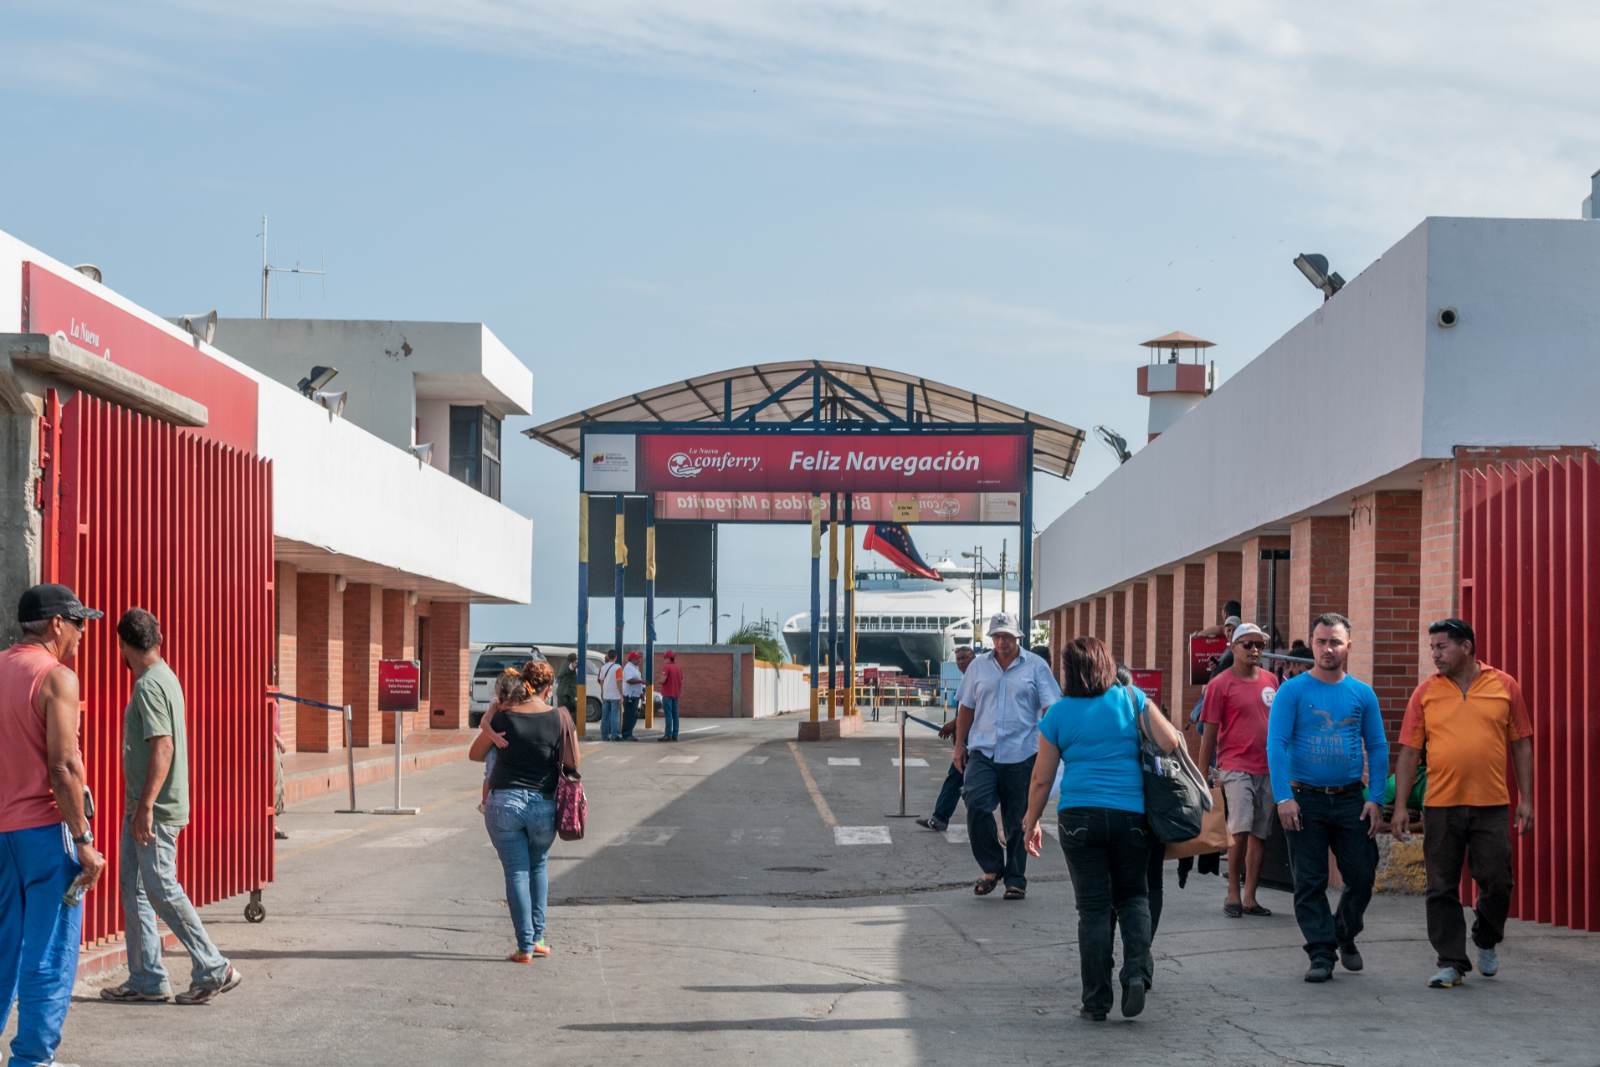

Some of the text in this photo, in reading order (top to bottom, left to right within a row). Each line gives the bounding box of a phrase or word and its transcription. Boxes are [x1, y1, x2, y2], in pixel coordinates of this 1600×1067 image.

[71, 316, 100, 348] La Nueva
[694, 452, 761, 472] conferry
[789, 450, 980, 476] Feliz Navegación
